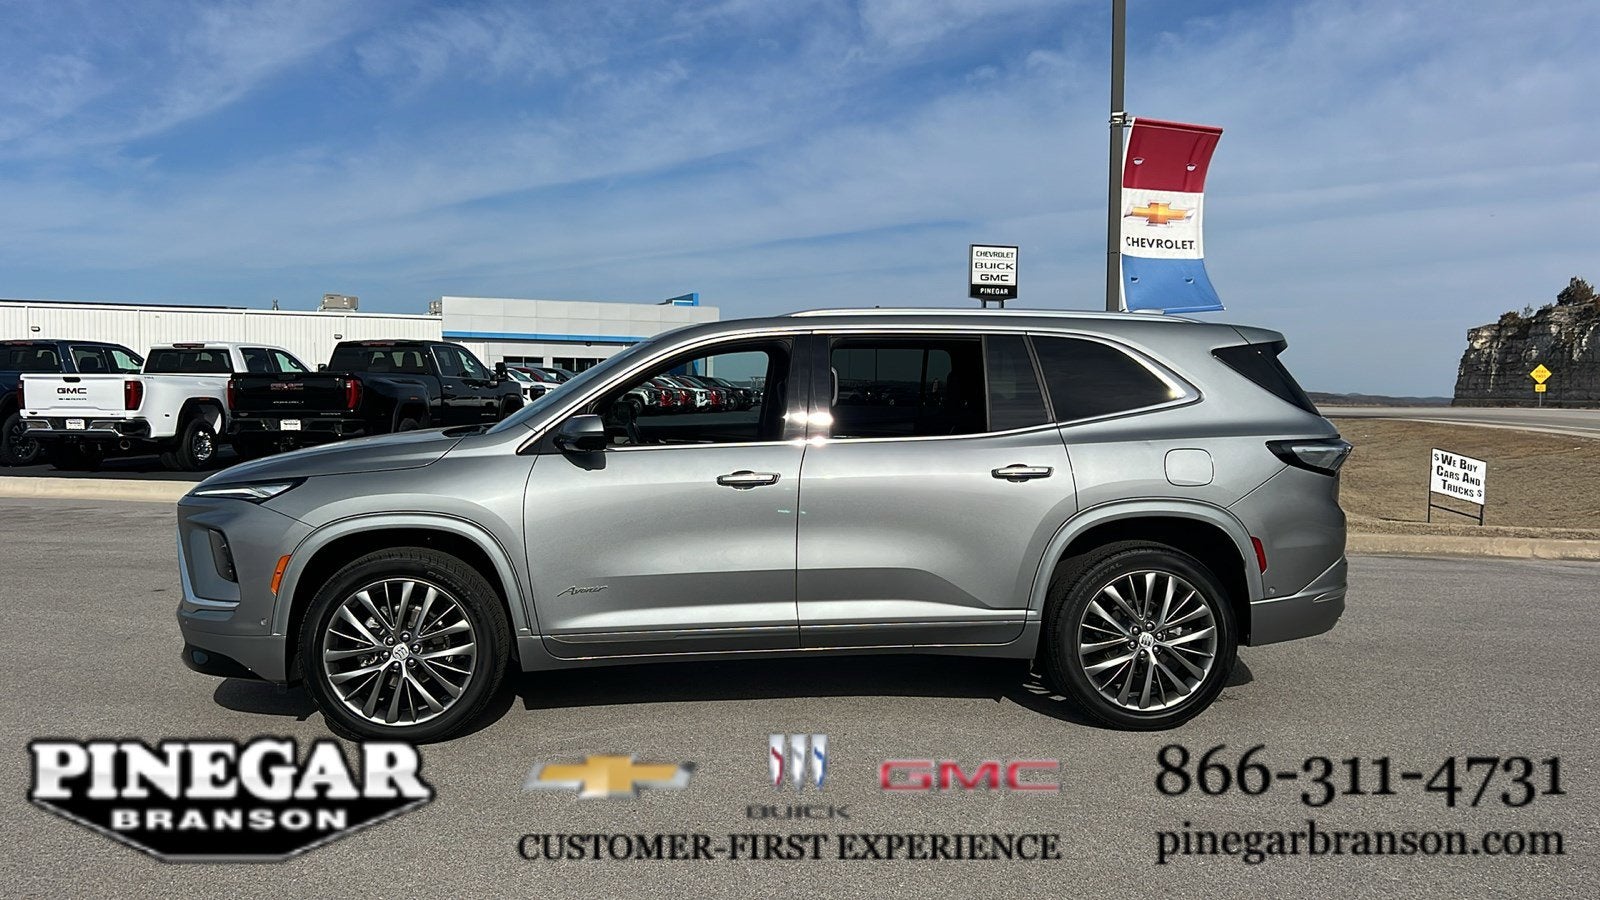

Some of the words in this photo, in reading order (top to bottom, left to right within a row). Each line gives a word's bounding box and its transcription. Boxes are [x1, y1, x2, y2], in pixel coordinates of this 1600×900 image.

[1125, 236, 1195, 250] CHEVROLET
[976, 250, 1014, 259] CHEVROLET
[975, 262, 1014, 270] BUICK
[980, 273, 1009, 282] GMC
[980, 287, 1009, 295] PINEGAR
[57, 387, 87, 395] GMC
